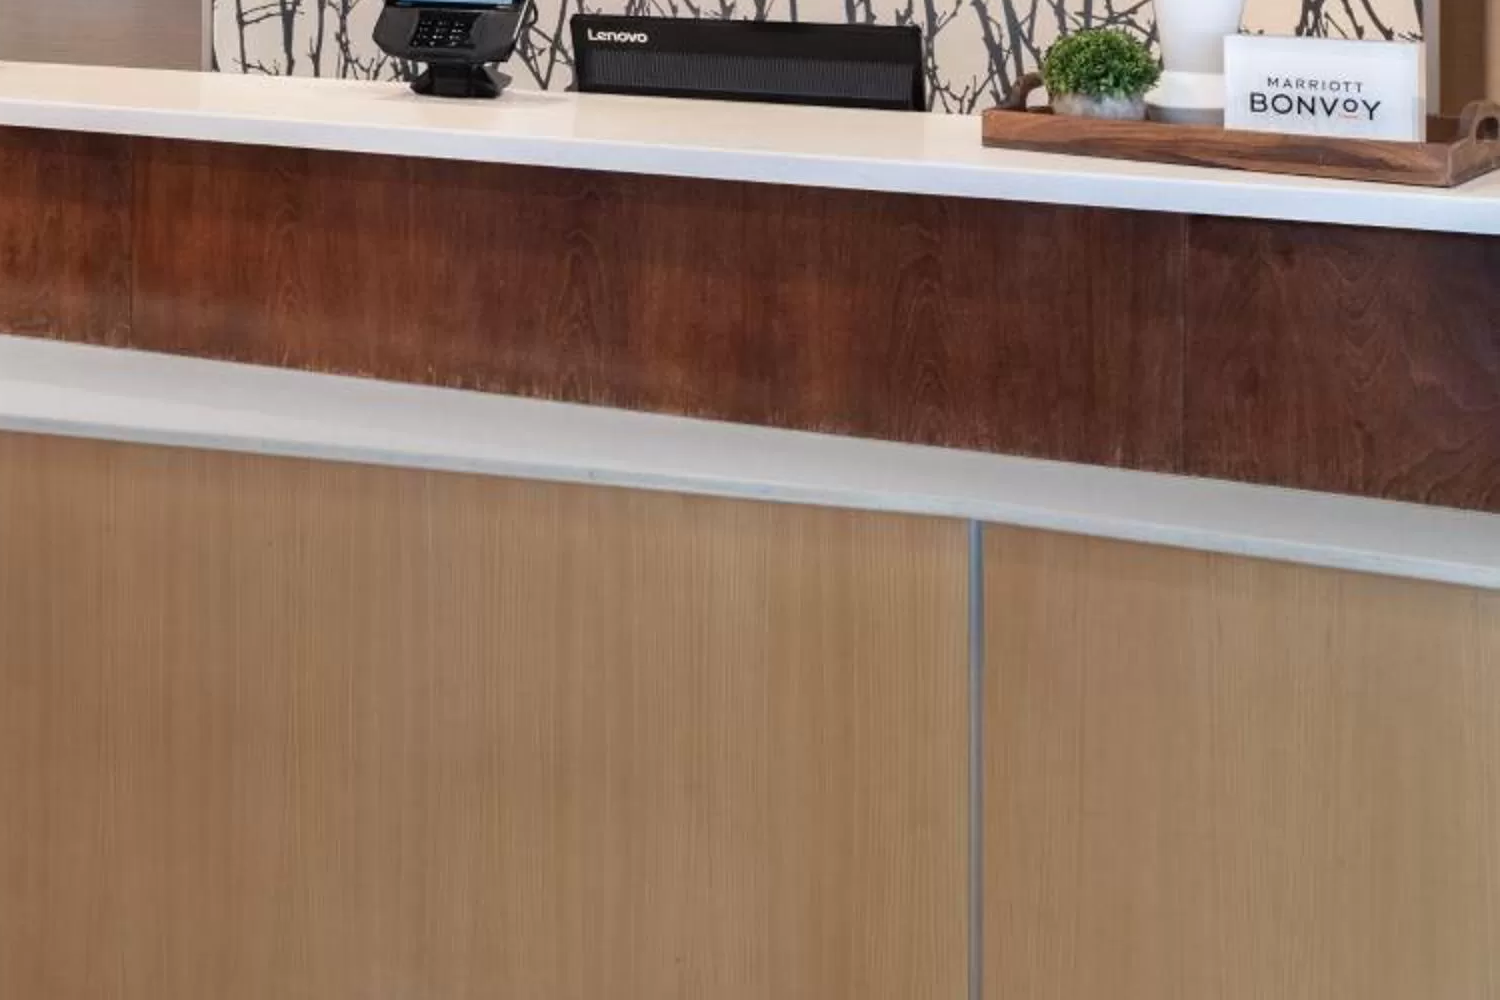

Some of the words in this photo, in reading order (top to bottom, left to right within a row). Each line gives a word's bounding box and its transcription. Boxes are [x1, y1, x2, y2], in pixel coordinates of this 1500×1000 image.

[587, 27, 648, 43] Lenovo
[1267, 77, 1363, 93] MARRIOTT
[1249, 92, 1381, 121] BONVOY
